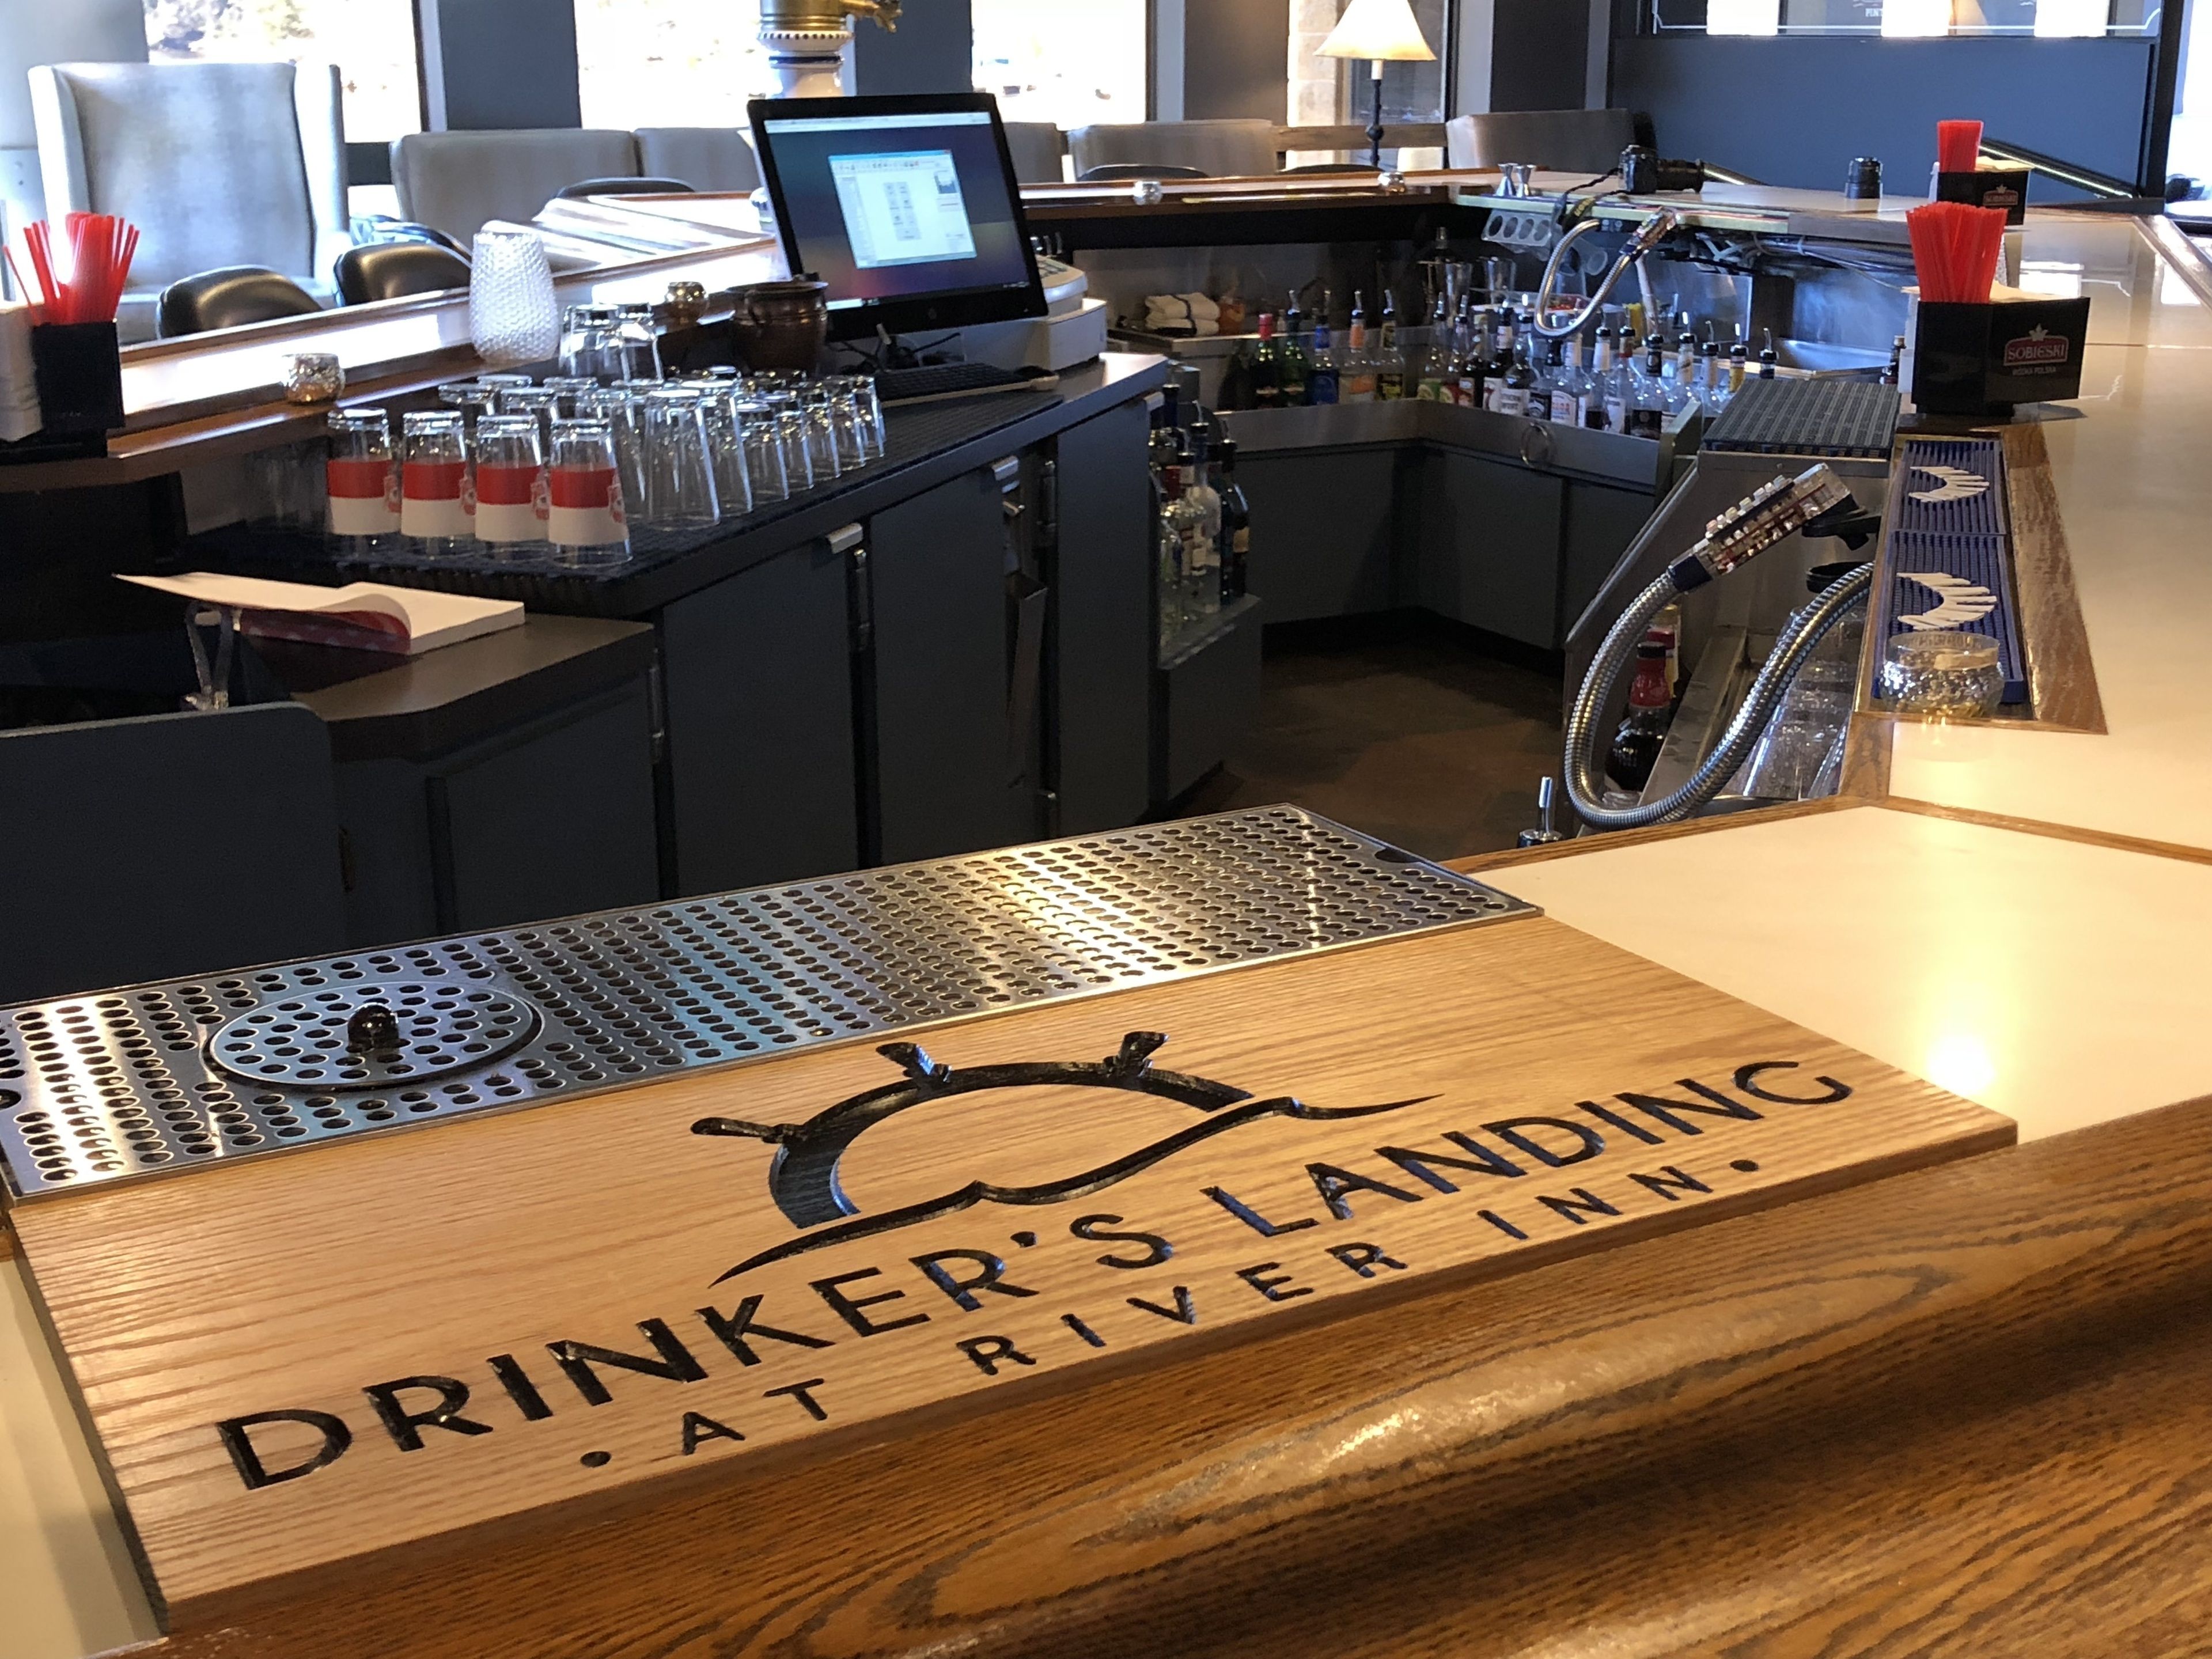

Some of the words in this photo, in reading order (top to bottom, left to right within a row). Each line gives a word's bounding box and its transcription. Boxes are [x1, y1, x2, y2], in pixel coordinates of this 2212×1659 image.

[2008, 344, 2065, 359] SOBIESKI
[216, 1213, 1173, 1490] DRINKER'S
[1199, 1060, 1853, 1237] LANDING
[681, 1378, 828, 1455] AT
[956, 1242, 1409, 1376] RIVER
[1477, 1165, 1714, 1240] INN
